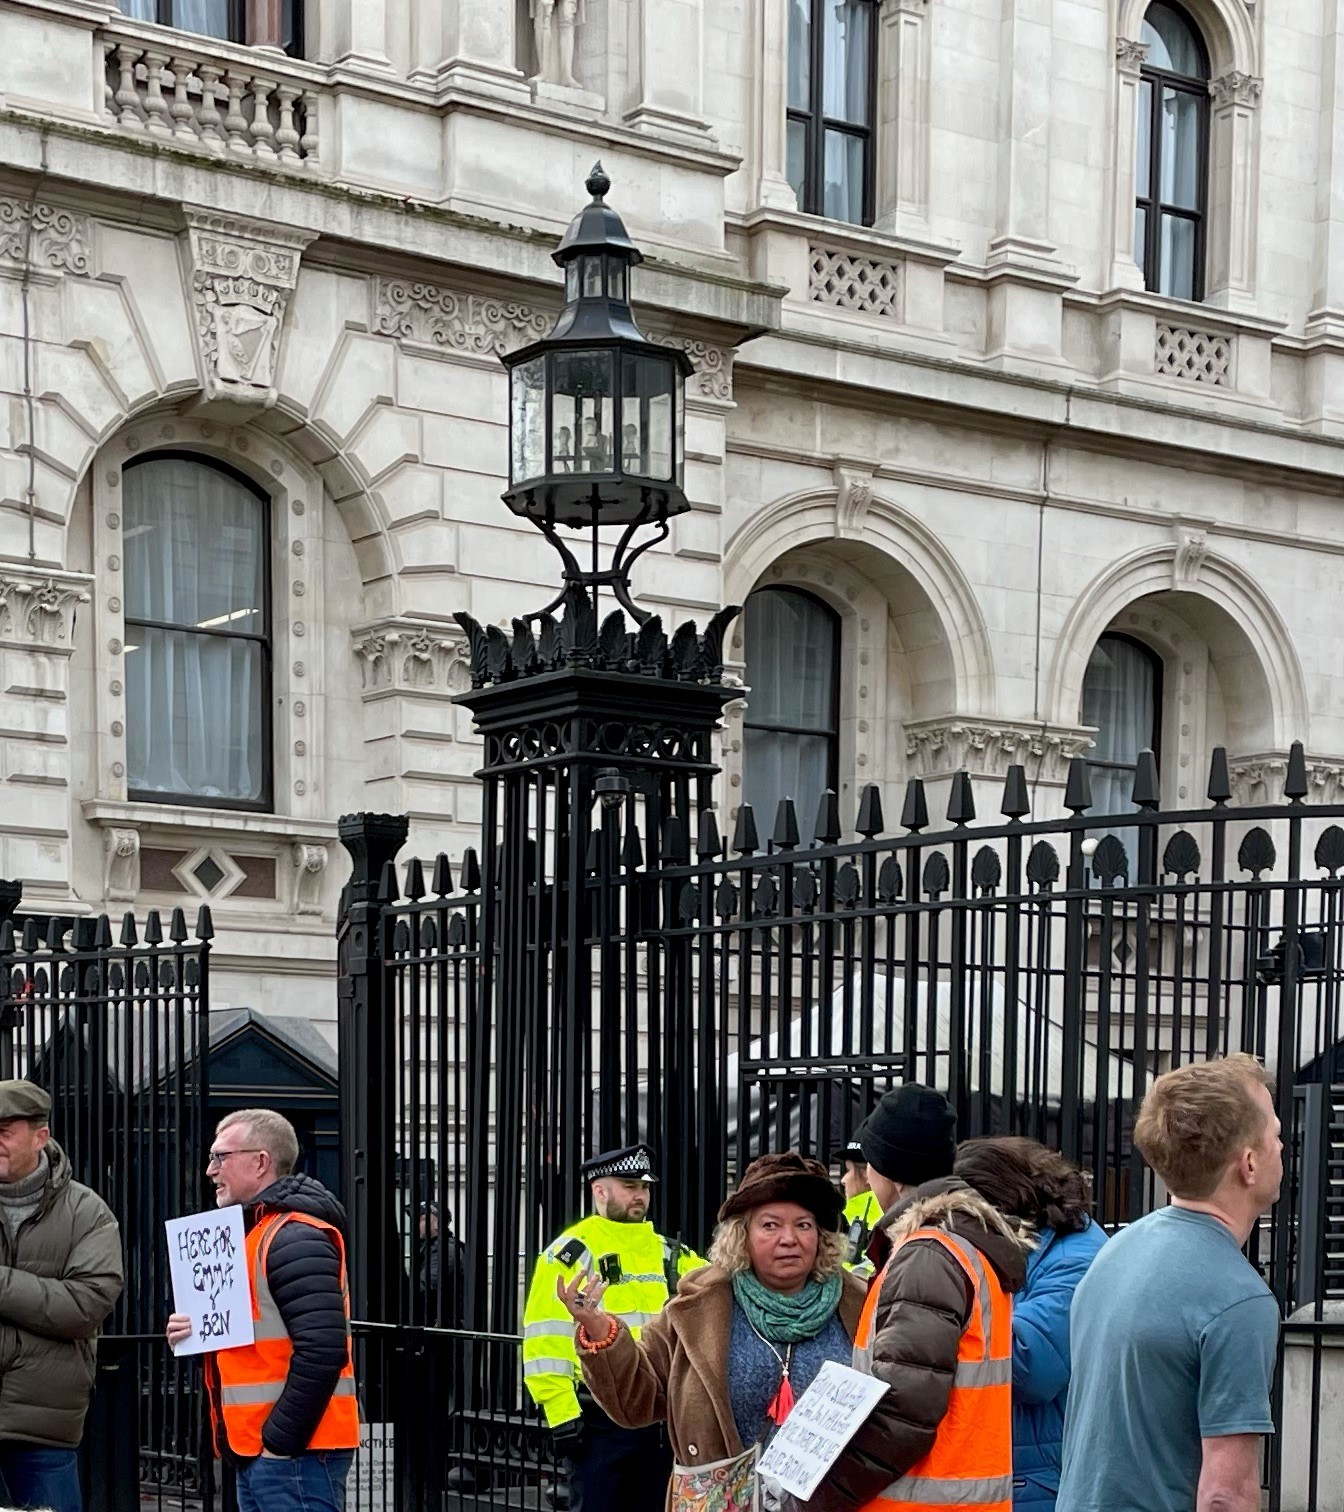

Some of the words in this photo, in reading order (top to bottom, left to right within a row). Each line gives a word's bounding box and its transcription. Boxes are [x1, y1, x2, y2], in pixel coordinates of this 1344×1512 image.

[177, 1227, 211, 1262] HERE
[192, 1262, 234, 1292] EMMA
[199, 1309, 231, 1343] BEN
